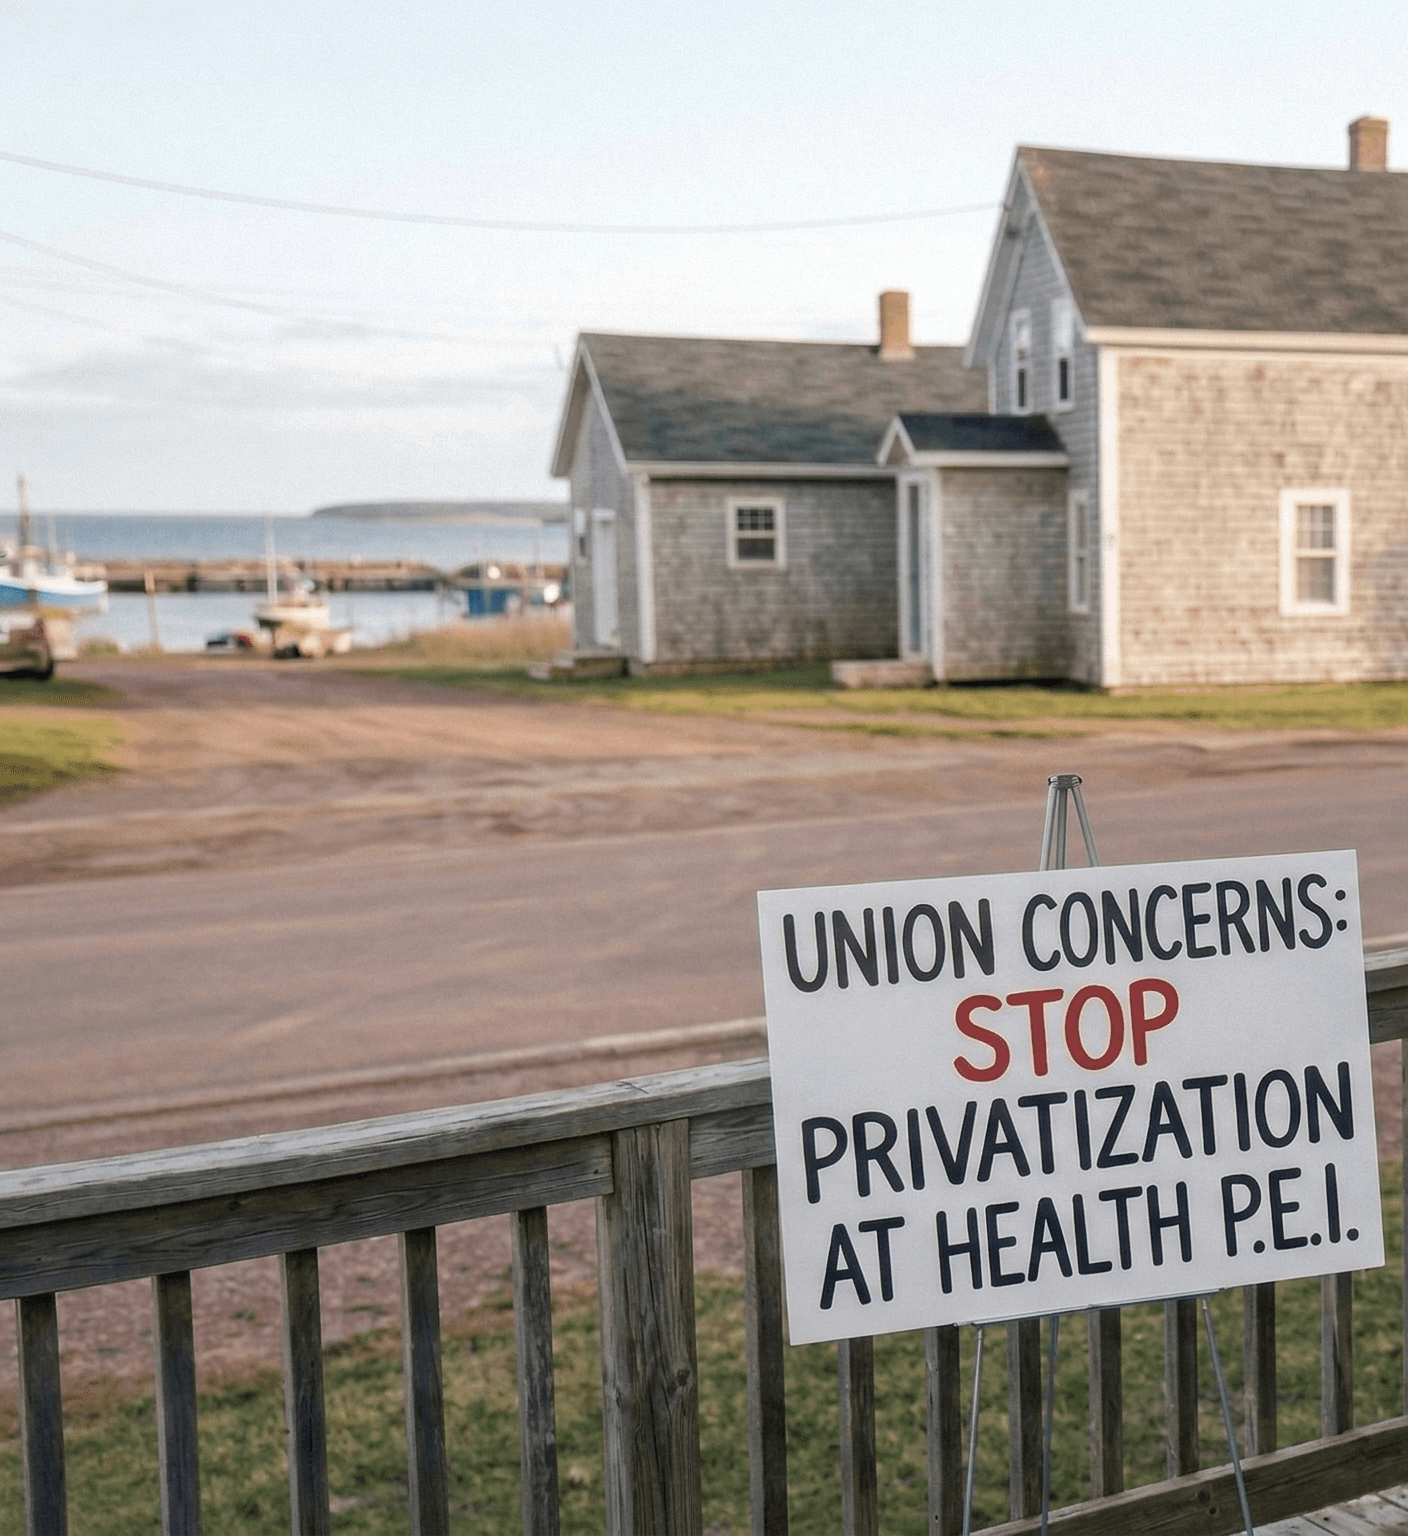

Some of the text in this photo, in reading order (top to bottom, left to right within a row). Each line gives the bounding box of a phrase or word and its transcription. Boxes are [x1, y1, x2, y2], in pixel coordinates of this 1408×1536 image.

[783, 873, 1349, 992] UNION CONCERNS:
[952, 978, 1179, 1082] STOP
[801, 1061, 1355, 1204] PRIVATIZATION
[820, 1163, 1360, 1310] AT HEALTH P.E.I.
